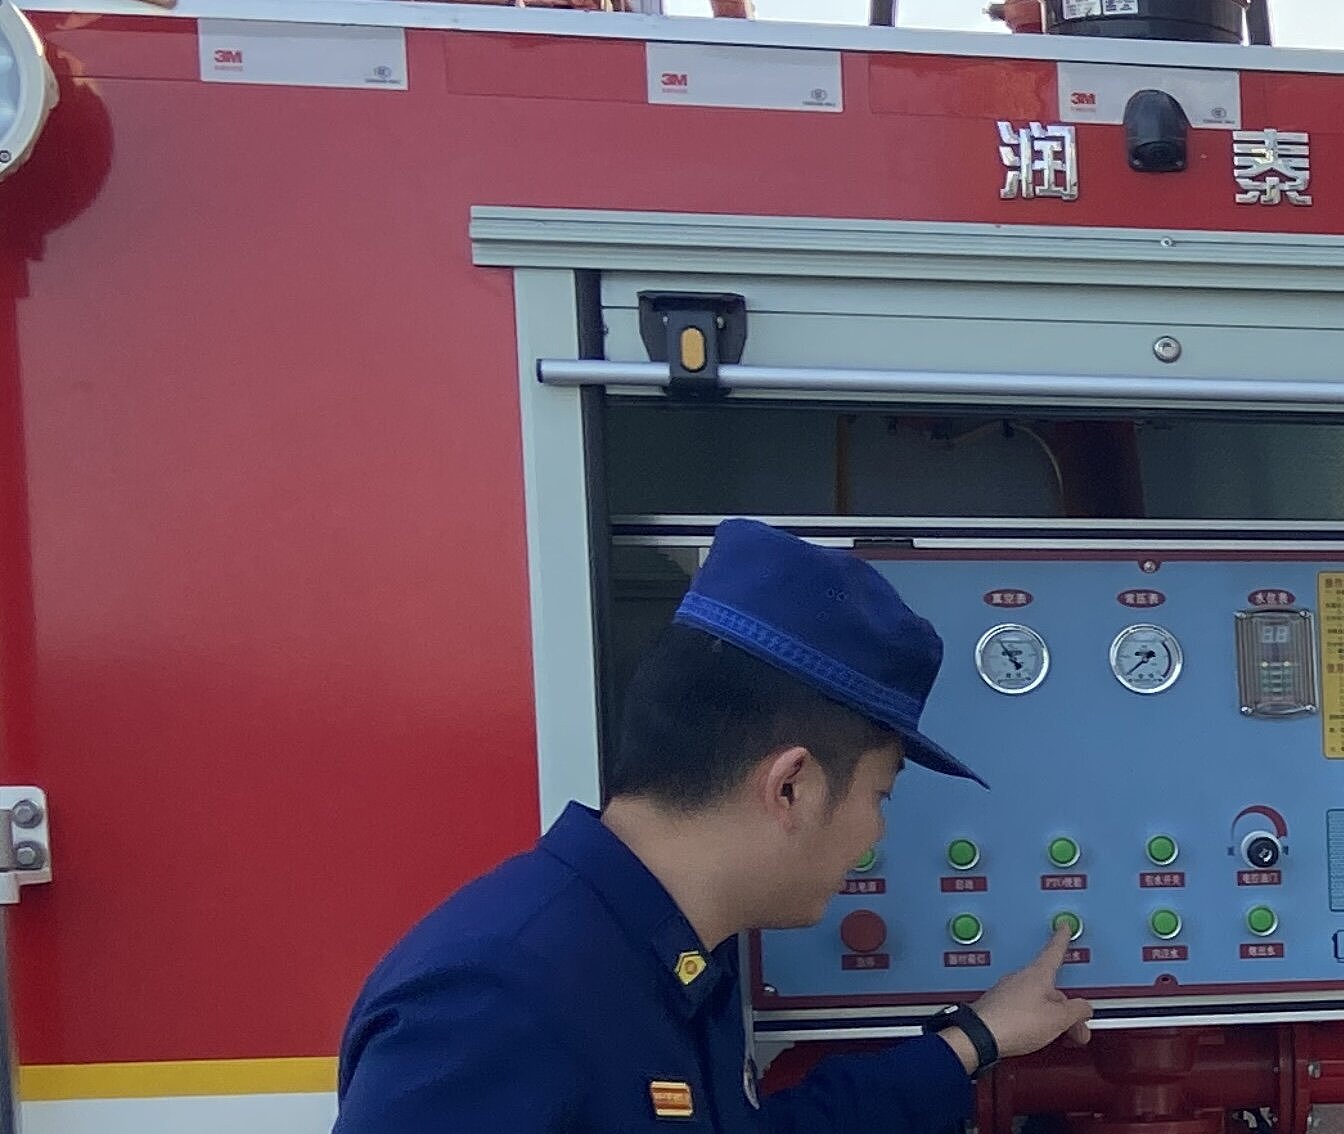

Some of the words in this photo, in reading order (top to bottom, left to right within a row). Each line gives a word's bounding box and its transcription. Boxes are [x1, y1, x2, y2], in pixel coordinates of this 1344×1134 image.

[213, 50, 242, 64] 3M
[661, 73, 688, 86] 3M
[1071, 92, 1096, 105] 3M
[997, 120, 1080, 201] 润
[1232, 128, 1313, 206] 泰
